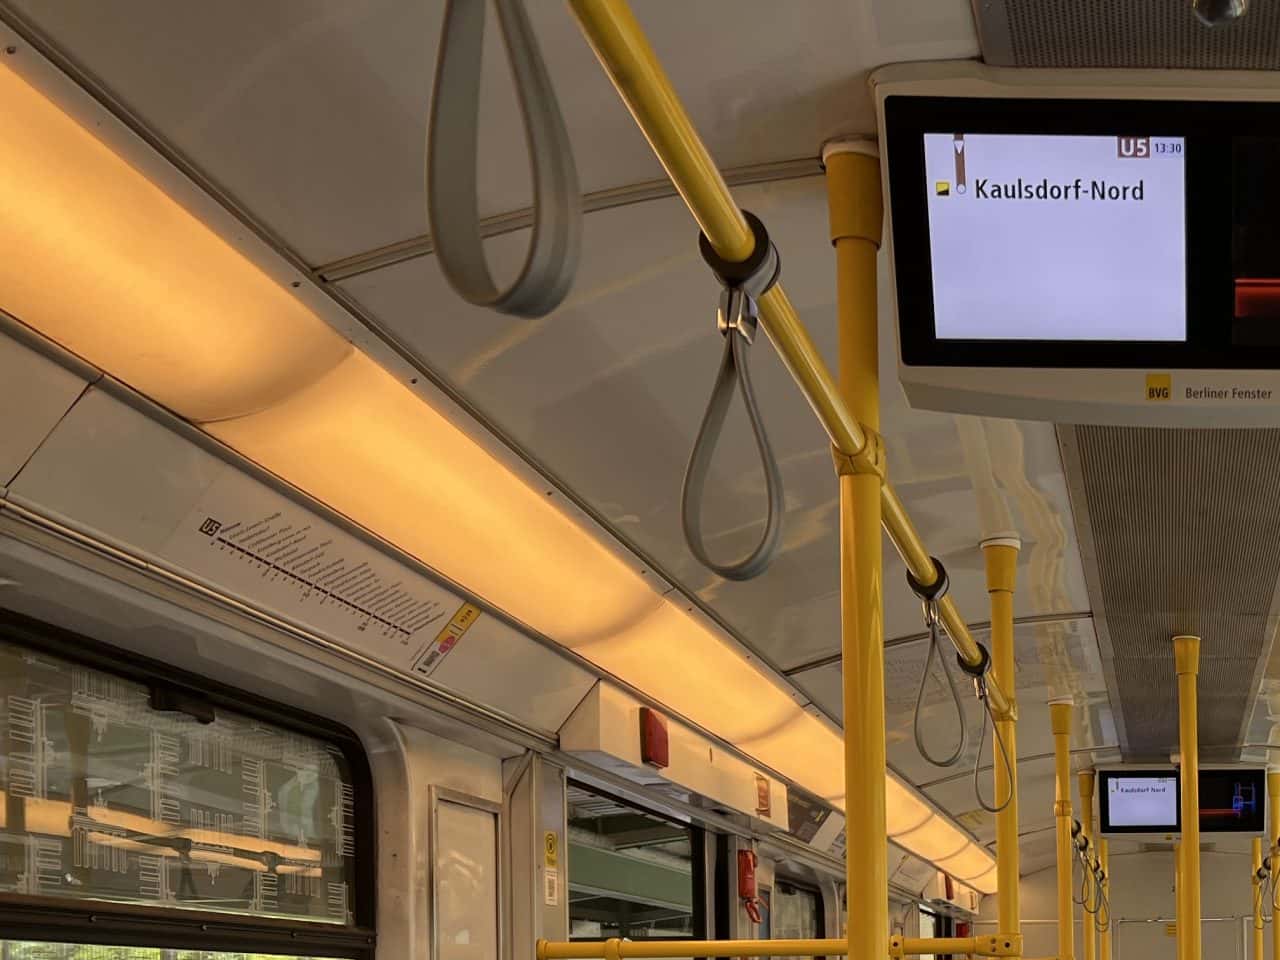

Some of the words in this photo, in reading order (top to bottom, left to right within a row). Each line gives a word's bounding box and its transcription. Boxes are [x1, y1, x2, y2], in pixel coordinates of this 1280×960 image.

[1120, 138, 1147, 157] U5
[1154, 142, 1182, 154] 13:30
[975, 178, 1144, 200] Kaulsdorf-Nord
[1148, 387, 1169, 399] BVG
[1185, 387, 1228, 399] Berliner
[1232, 388, 1273, 400] Fenster
[201, 519, 219, 535] U5
